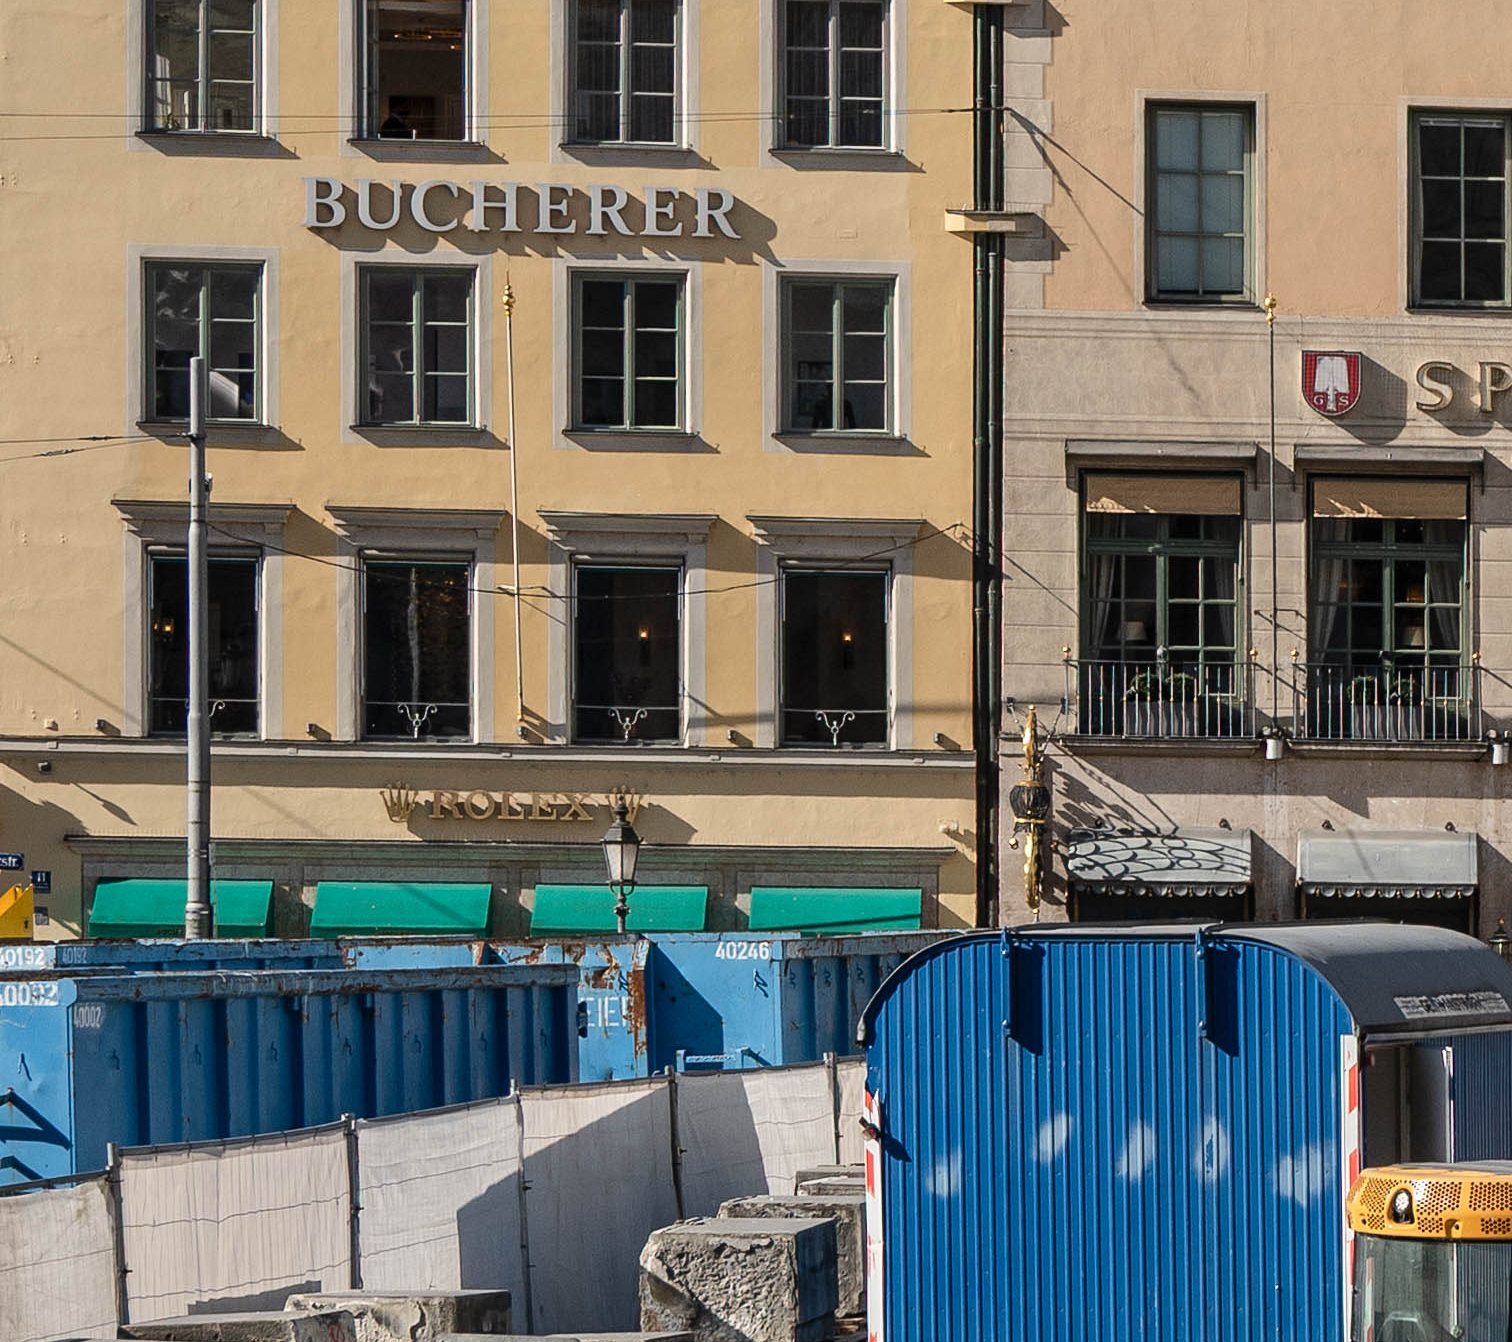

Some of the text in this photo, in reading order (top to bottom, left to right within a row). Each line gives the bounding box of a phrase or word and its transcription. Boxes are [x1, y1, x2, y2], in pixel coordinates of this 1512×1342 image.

[300, 176, 743, 239] BUCHERER
[429, 789, 594, 821] ROLEX
[715, 942, 769, 959] 40246
